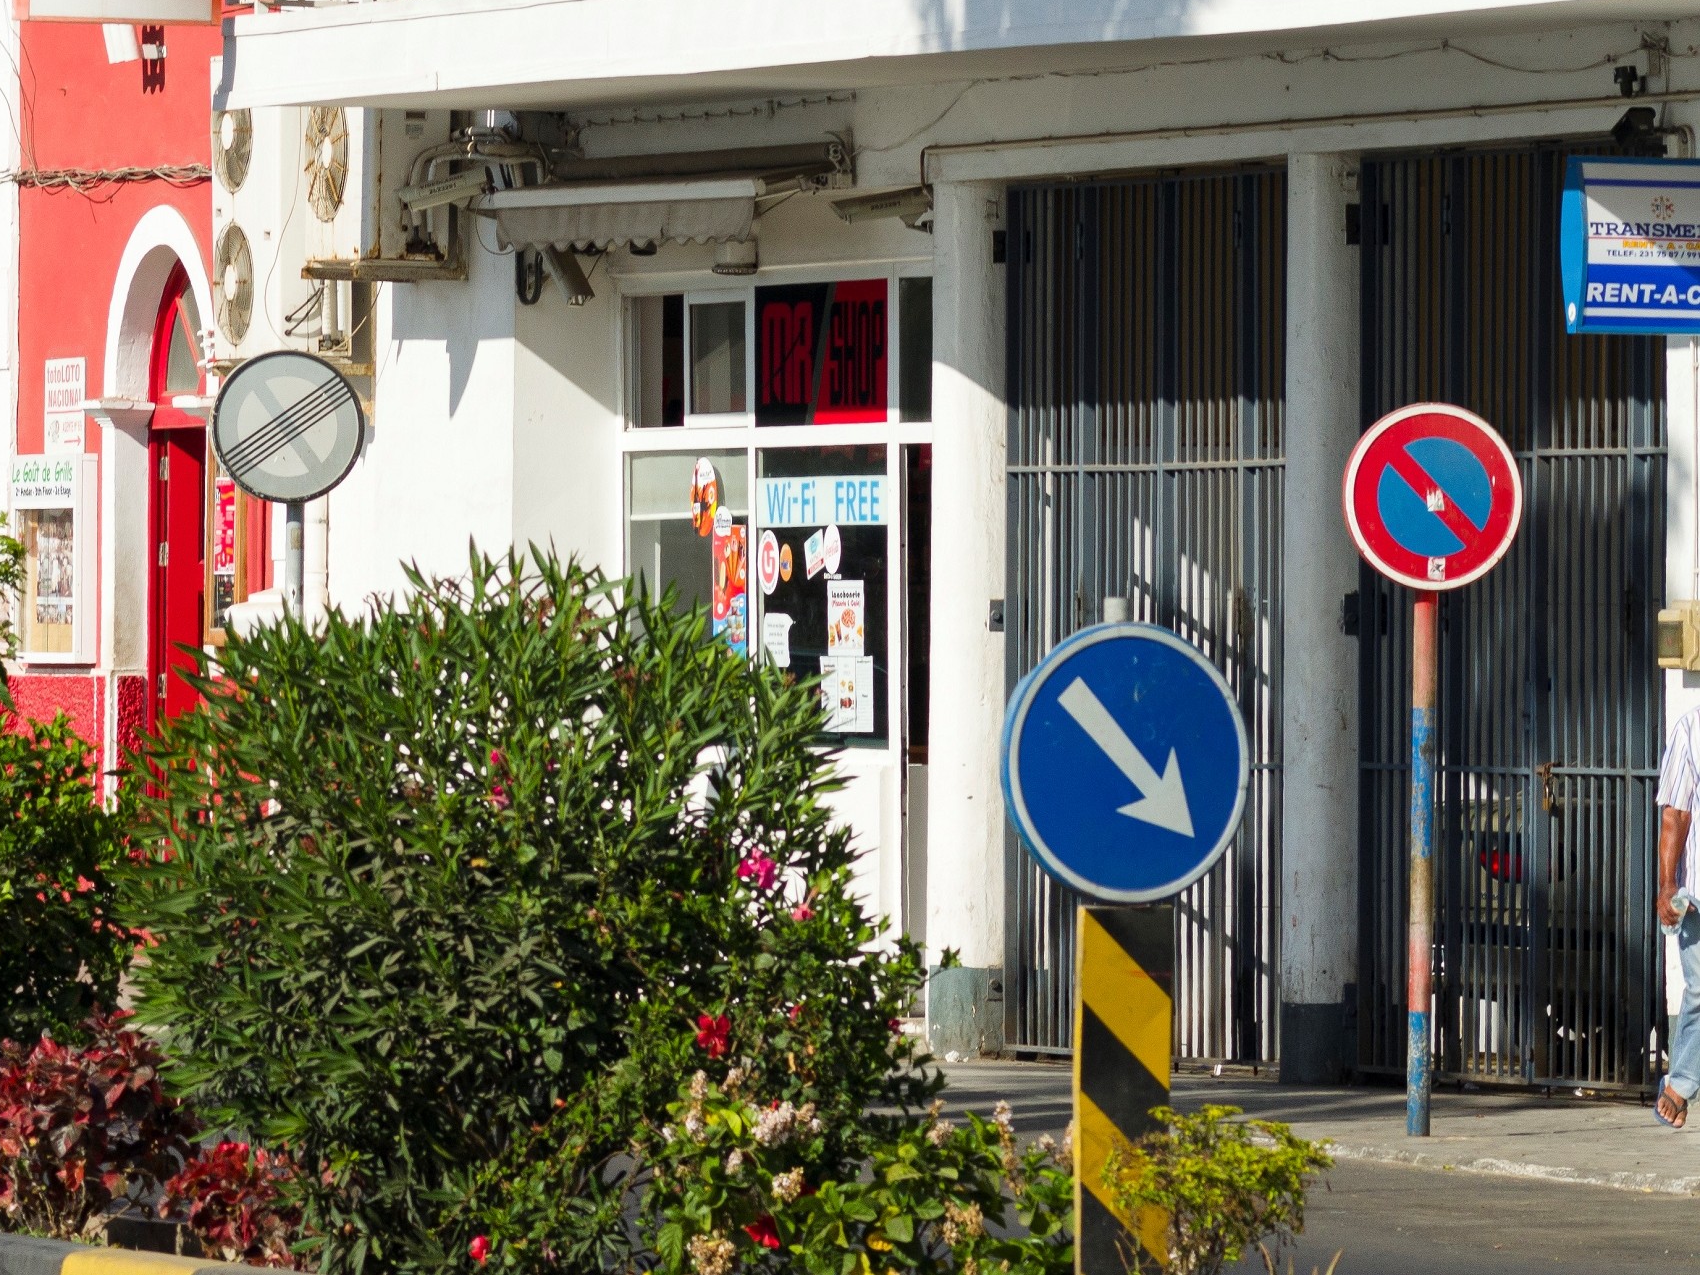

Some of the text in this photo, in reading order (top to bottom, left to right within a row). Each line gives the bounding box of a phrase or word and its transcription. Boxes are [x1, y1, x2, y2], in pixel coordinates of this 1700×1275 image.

[1590, 222, 1700, 239] TRANSME
[1686, 243, 1700, 251] CA
[1587, 282, 1700, 305] RENT-A-C
[830, 301, 884, 405] SHOP
[48, 364, 80, 383] totoLOTO
[12, 460, 73, 483] Le Goût de Grills
[767, 480, 880, 524] Wi-Fi FREE
